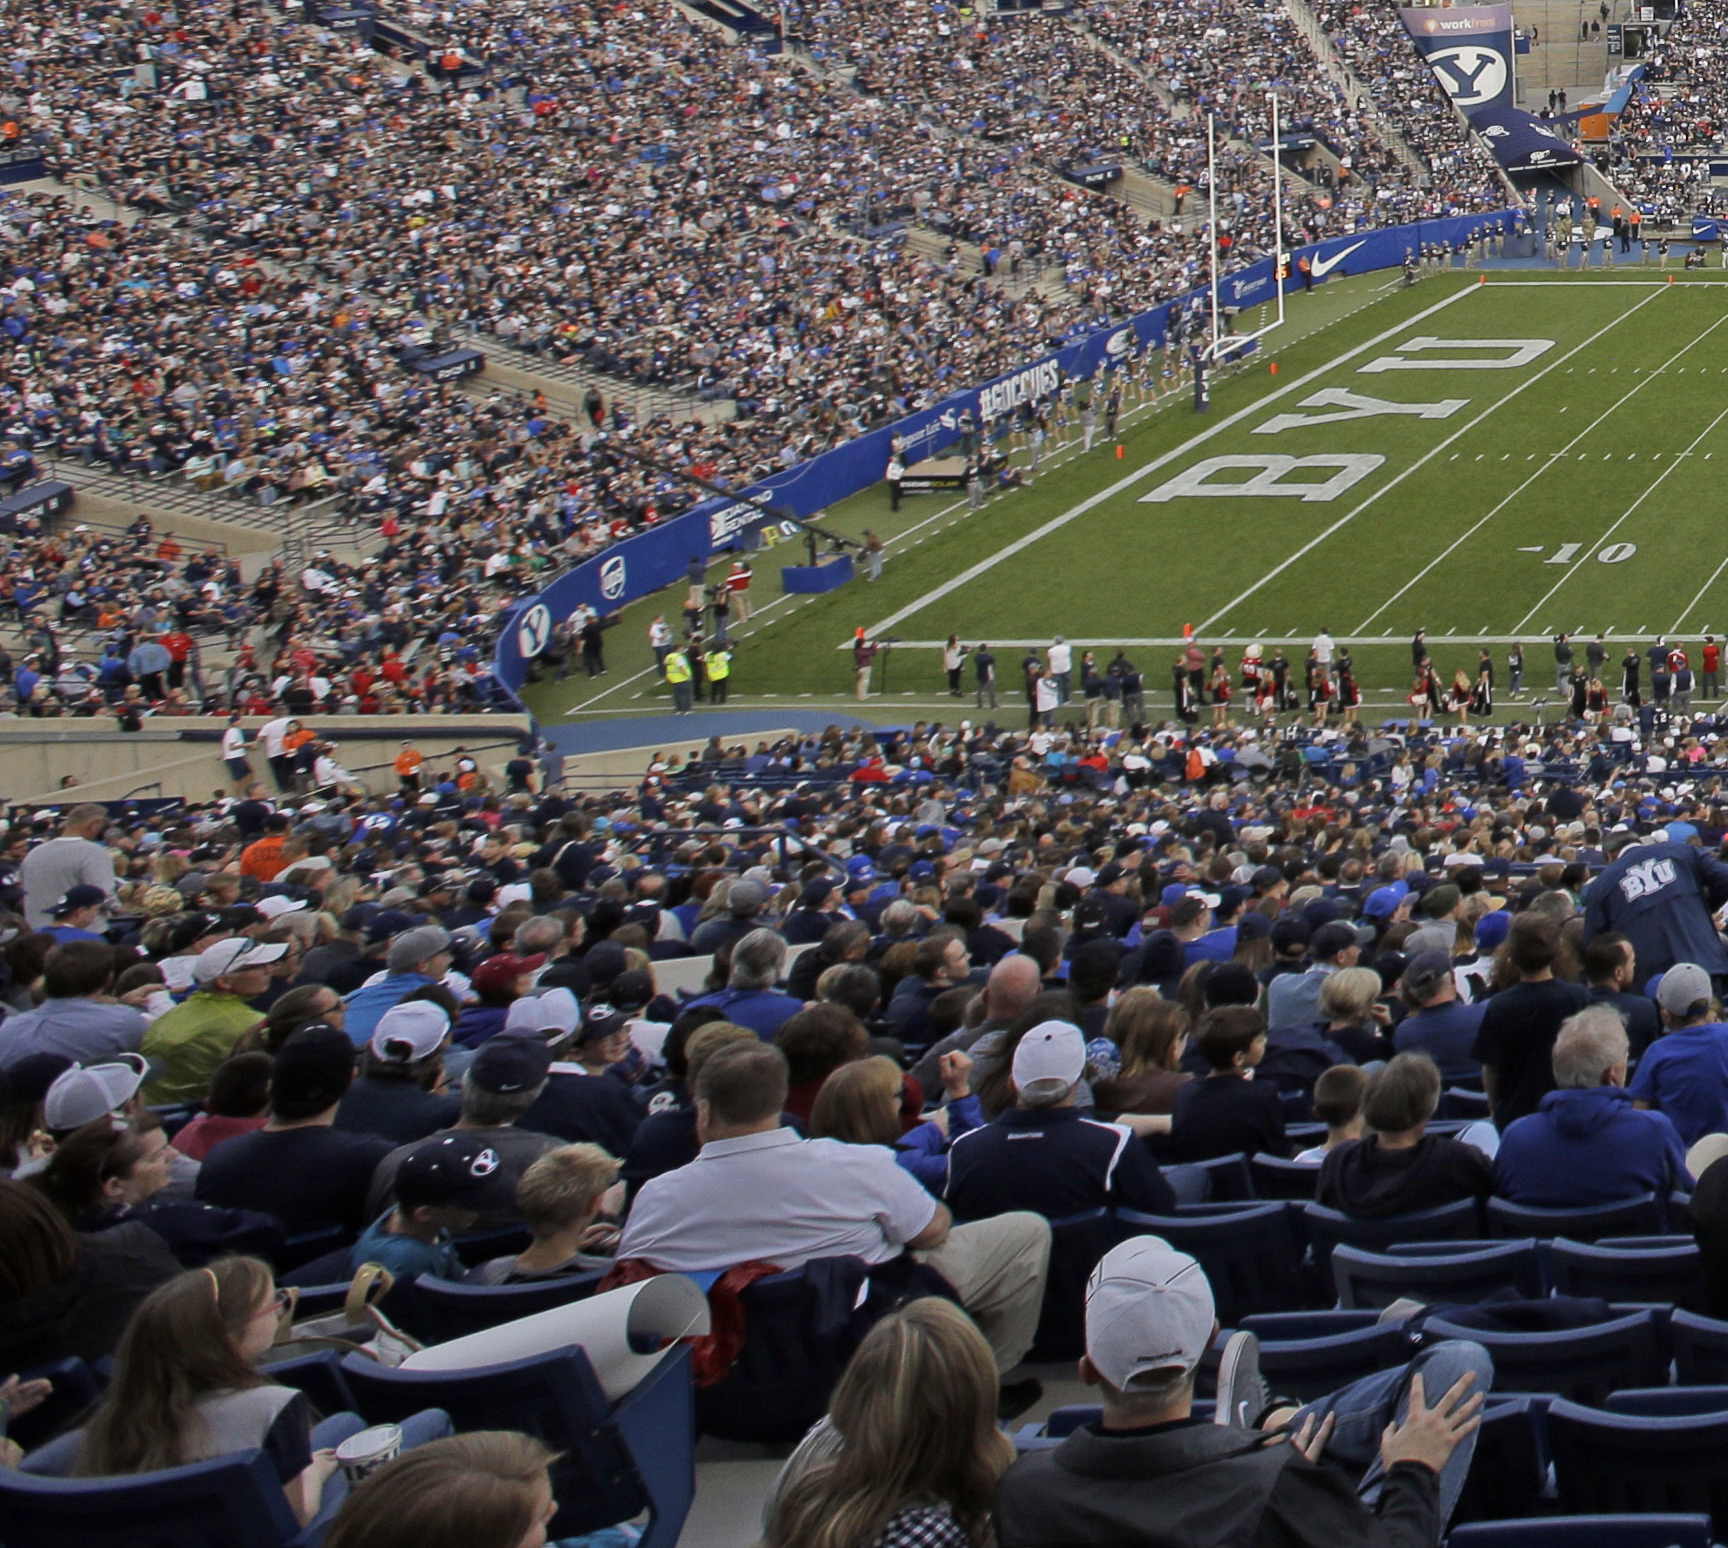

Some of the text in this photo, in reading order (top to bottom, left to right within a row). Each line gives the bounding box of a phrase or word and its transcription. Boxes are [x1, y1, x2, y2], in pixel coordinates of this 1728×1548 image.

[1441, 17, 1497, 31] workfront
[1137, 336, 1556, 503] BYU
[1543, 542, 1638, 565] 10
[1620, 858, 1678, 902] BYU
